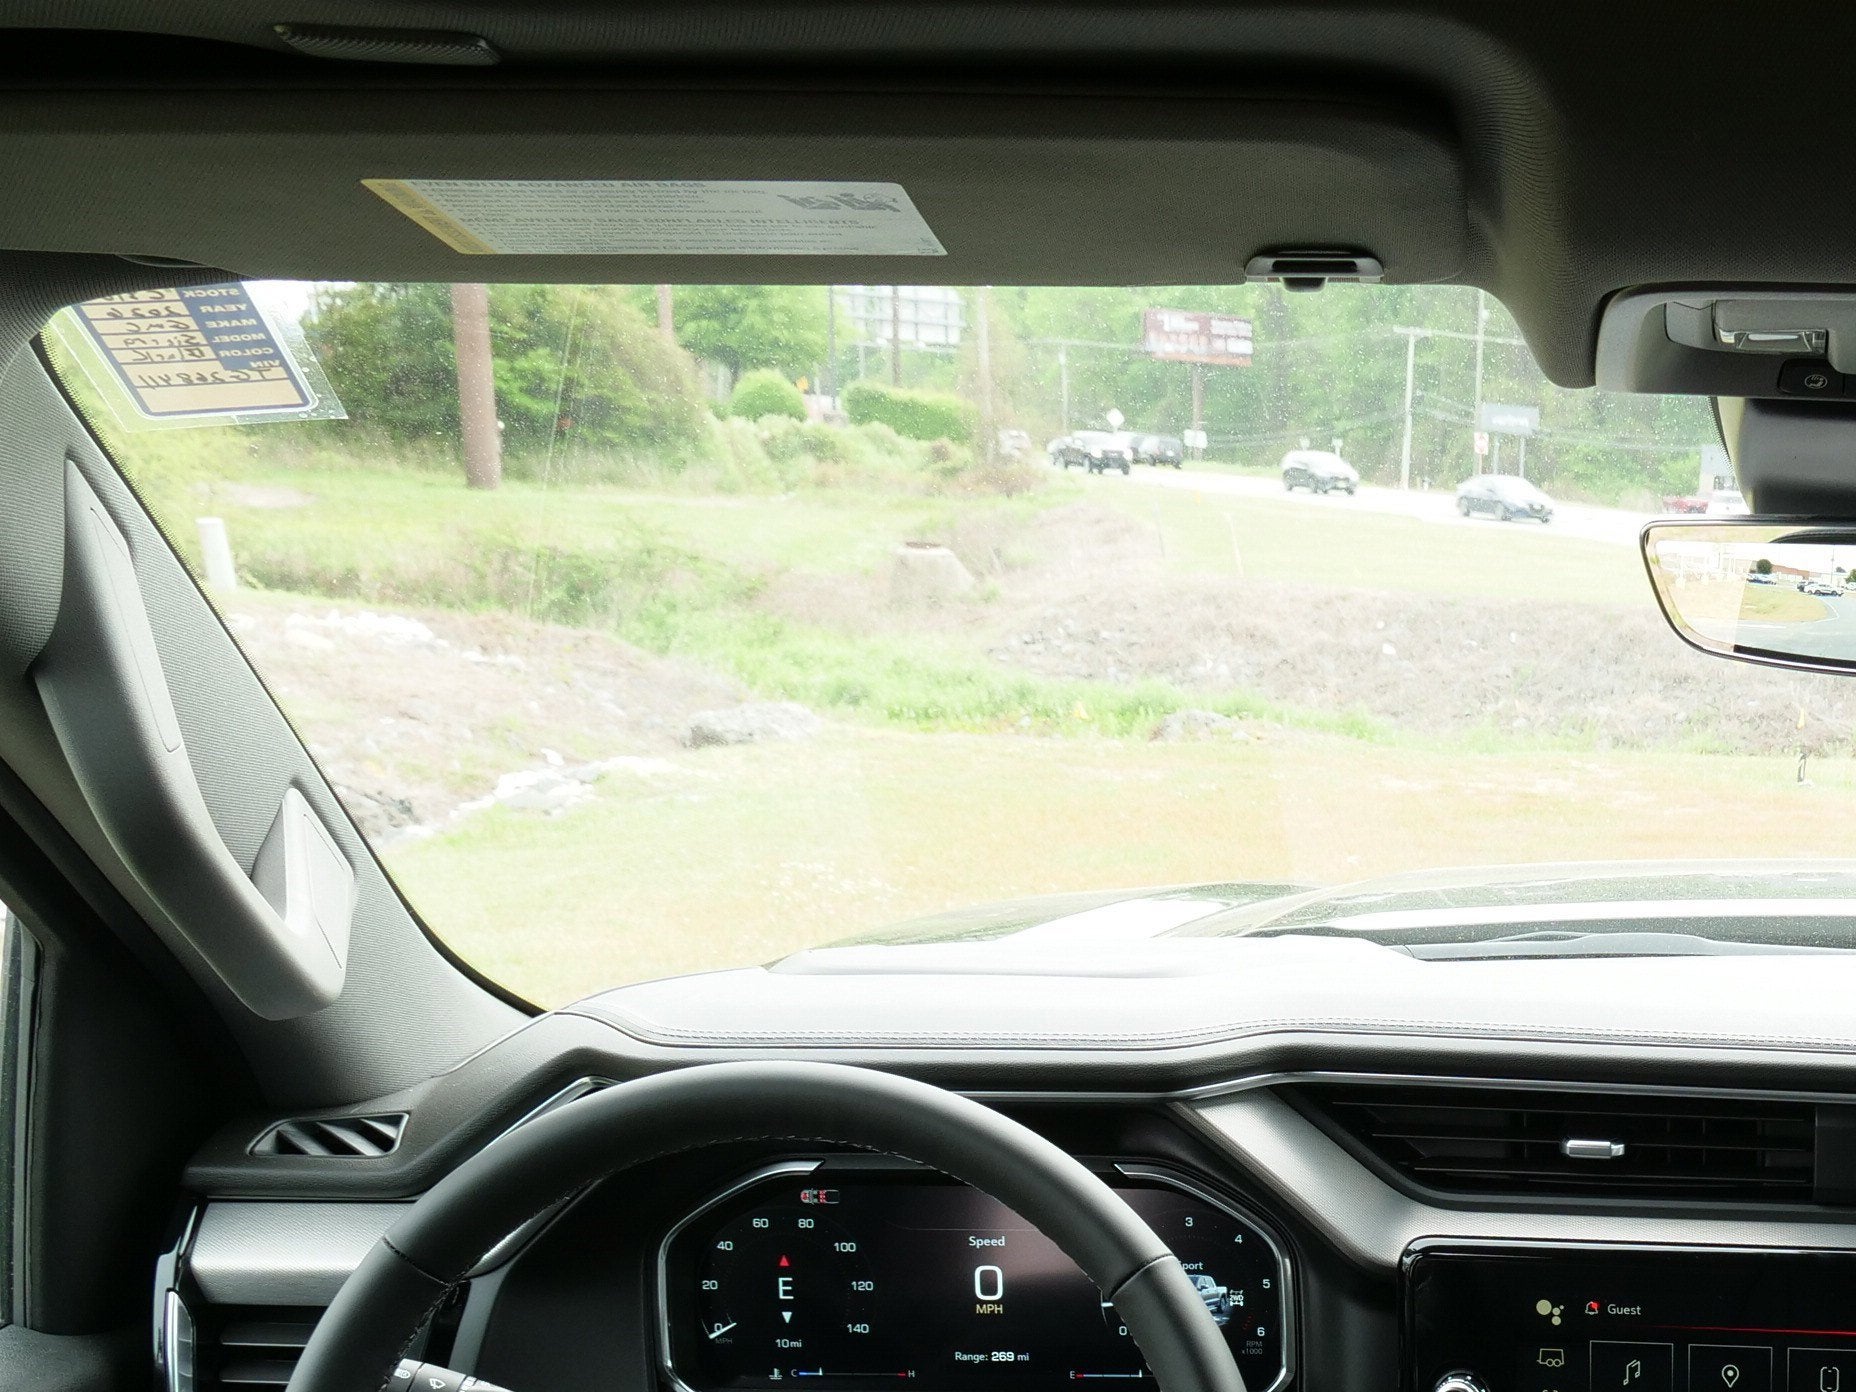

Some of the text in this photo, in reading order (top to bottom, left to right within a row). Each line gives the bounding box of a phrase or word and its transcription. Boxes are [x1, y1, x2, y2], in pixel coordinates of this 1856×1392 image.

[752, 1218, 769, 1229] 60
[798, 1218, 814, 1229] 80
[1184, 1216, 1194, 1228] 3
[969, 1236, 1005, 1249] Speed
[1234, 1234, 1244, 1244] 4
[717, 1241, 734, 1251] 40
[833, 1242, 857, 1252] 100
[1181, 1261, 1204, 1272] port
[702, 1280, 719, 1290] 20
[778, 1277, 794, 1299] E
[851, 1281, 874, 1291] 120
[974, 1265, 1004, 1300] 0
[1262, 1278, 1271, 1289] 5
[975, 1304, 1003, 1315] MPH
[1607, 1303, 1642, 1316] Guest
[846, 1323, 869, 1334] 140
[1118, 1325, 1128, 1336] 0
[1256, 1326, 1267, 1337] 6
[1246, 1340, 1262, 1348] RPM
[955, 1351, 1030, 1363] Range: 269 mi
[790, 1369, 798, 1378] C
[908, 1370, 916, 1378] H
